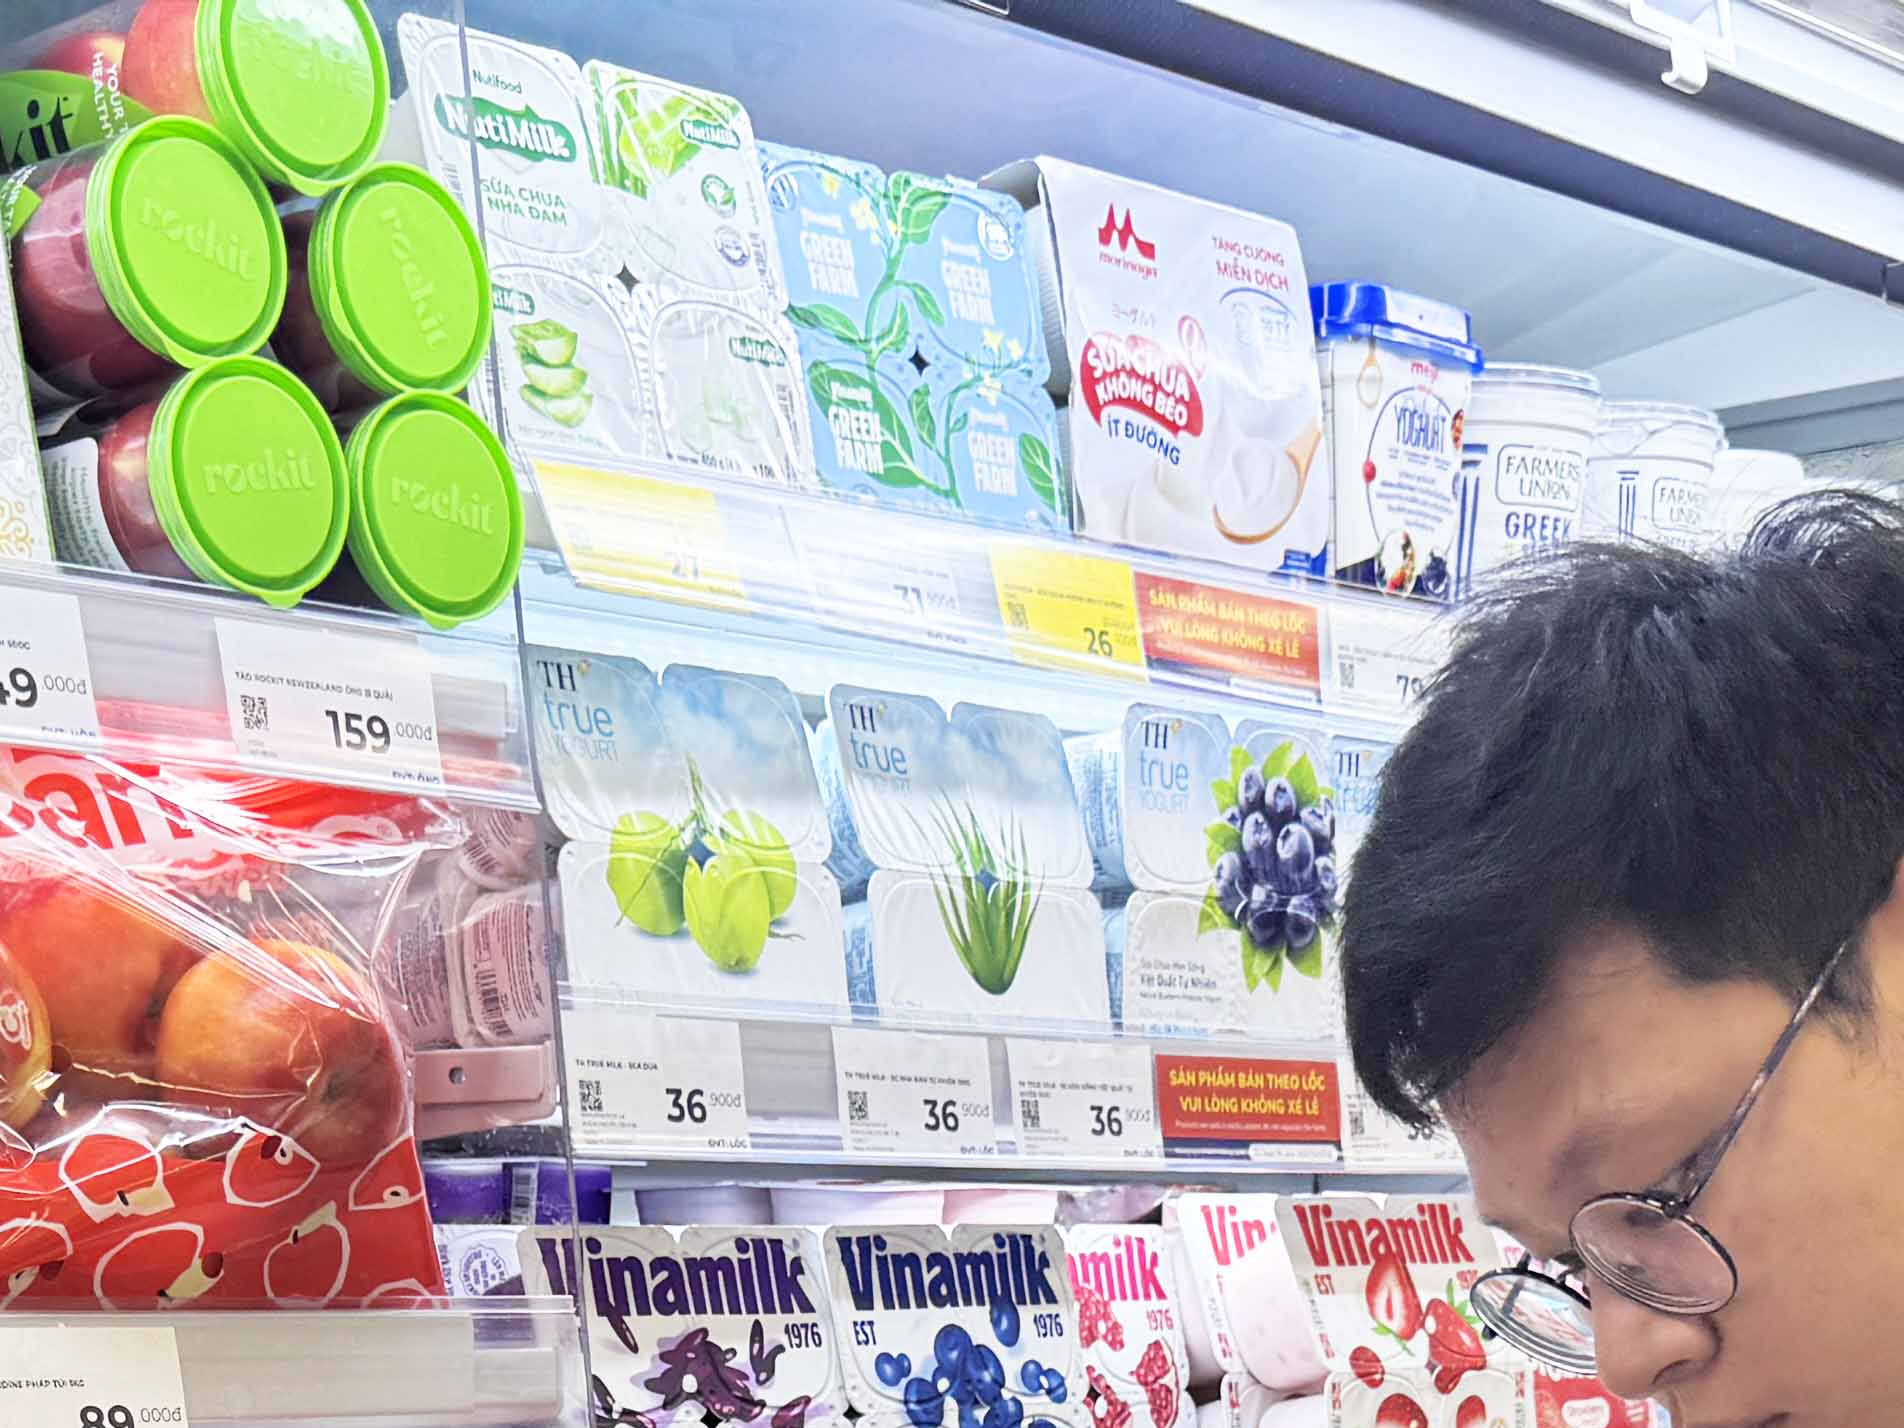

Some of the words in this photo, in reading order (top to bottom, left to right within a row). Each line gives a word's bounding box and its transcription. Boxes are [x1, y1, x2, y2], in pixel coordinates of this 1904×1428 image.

[136, 200, 258, 283] rockit
[378, 205, 448, 352] rockit
[203, 450, 318, 495] rockit
[391, 475, 498, 537] rockit
[1504, 511, 1573, 543] GREEK
[534, 659, 577, 696] TH
[324, 709, 392, 755] 159
[542, 696, 615, 740] true
[842, 702, 878, 733] TH
[1139, 719, 1173, 750] TH
[848, 731, 909, 776] true
[1137, 753, 1191, 791] true
[1266, 1074, 1299, 1091] THEO
[665, 1086, 708, 1124] 36
[922, 1098, 959, 1133] 36
[1089, 1104, 1123, 1137] 36
[1179, 1096, 1202, 1113] VUI
[1292, 1202, 1476, 1269] Vinamilk
[538, 1235, 817, 1321] Vinamilk
[836, 1231, 1061, 1313] Vinamilk
[783, 1321, 824, 1351] 1976
[854, 1320, 877, 1347] EST
[1032, 1313, 1064, 1339] 1976
